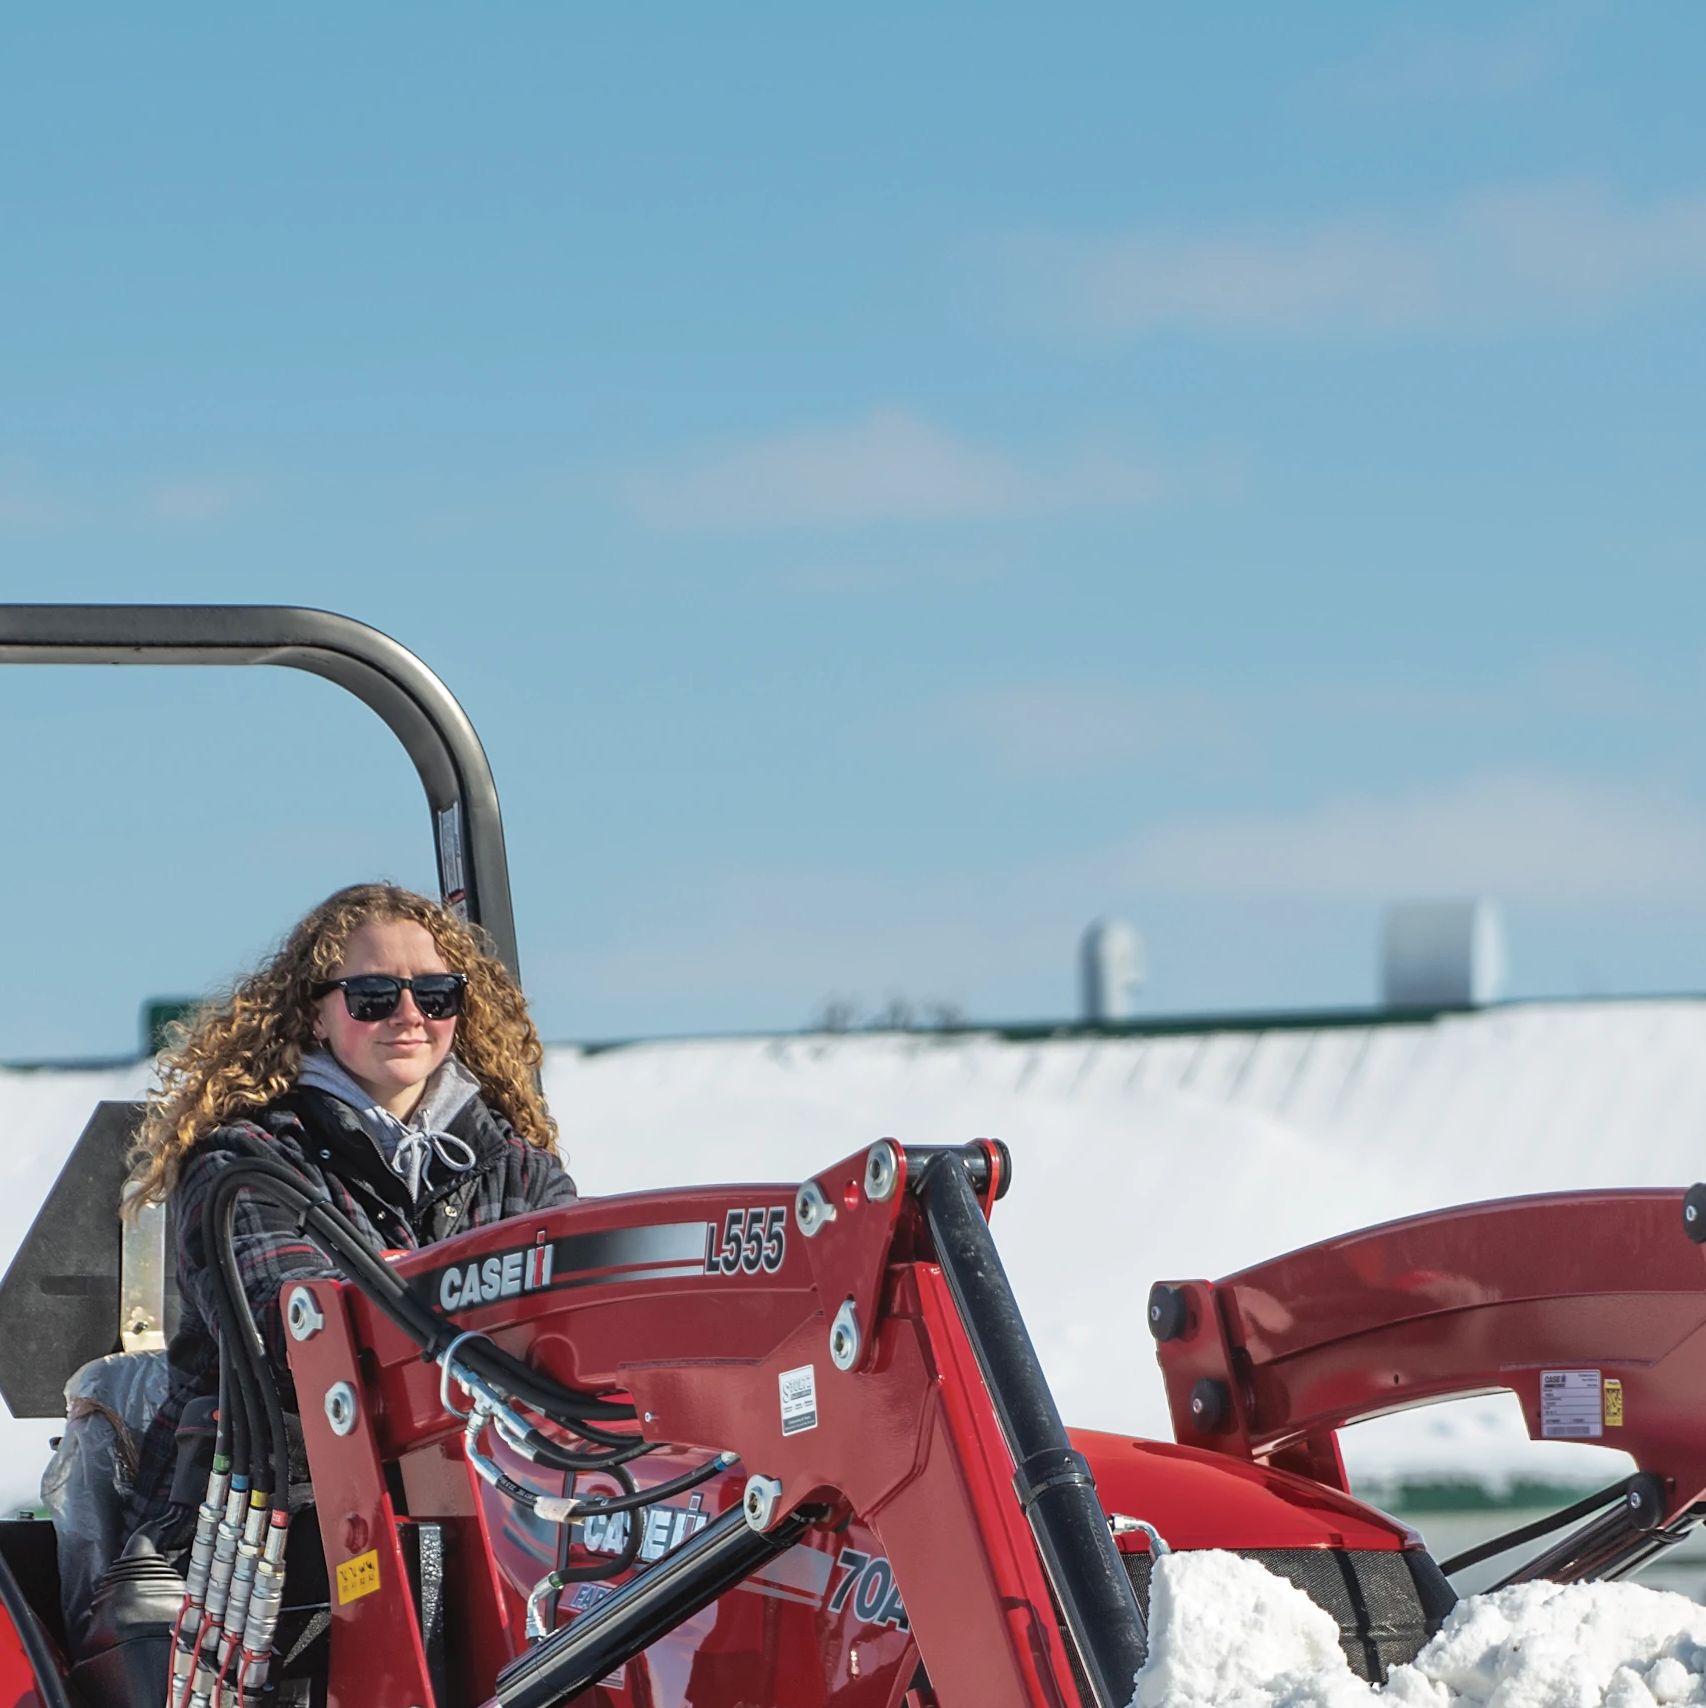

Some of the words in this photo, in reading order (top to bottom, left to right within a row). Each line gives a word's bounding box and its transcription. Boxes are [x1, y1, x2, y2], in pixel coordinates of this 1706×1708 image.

[705, 1205, 787, 1275] L555
[440, 1256, 524, 1311] CASE
[584, 1511, 674, 1562] CAE
[827, 1547, 910, 1634] 70A
